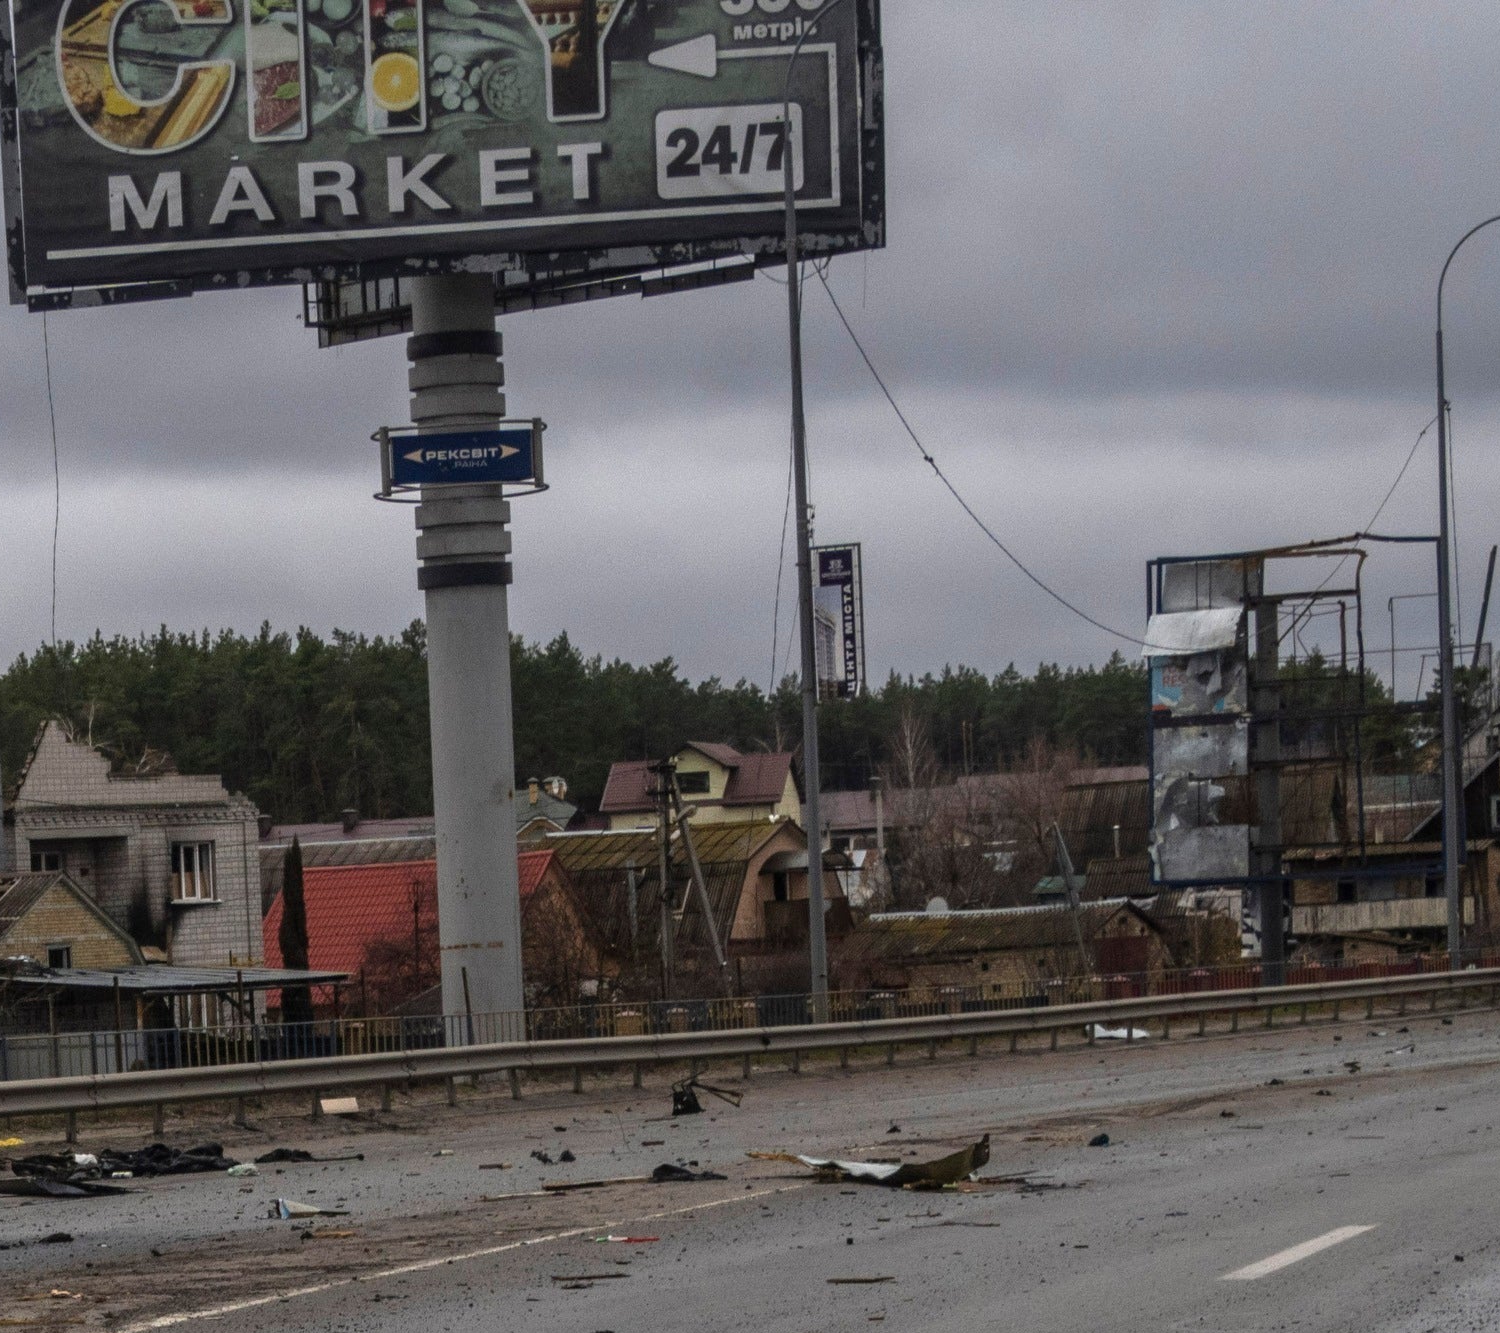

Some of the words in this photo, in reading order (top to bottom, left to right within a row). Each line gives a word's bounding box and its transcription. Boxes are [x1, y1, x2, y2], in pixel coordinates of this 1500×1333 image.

[732, 18, 818, 42] метрів
[665, 121, 792, 178] 24/7
[107, 141, 602, 232] MARKET
[425, 447, 499, 461] РЕКСВІТ
[843, 583, 854, 635] МІСТА
[845, 641, 856, 692] ЦЕНТР
